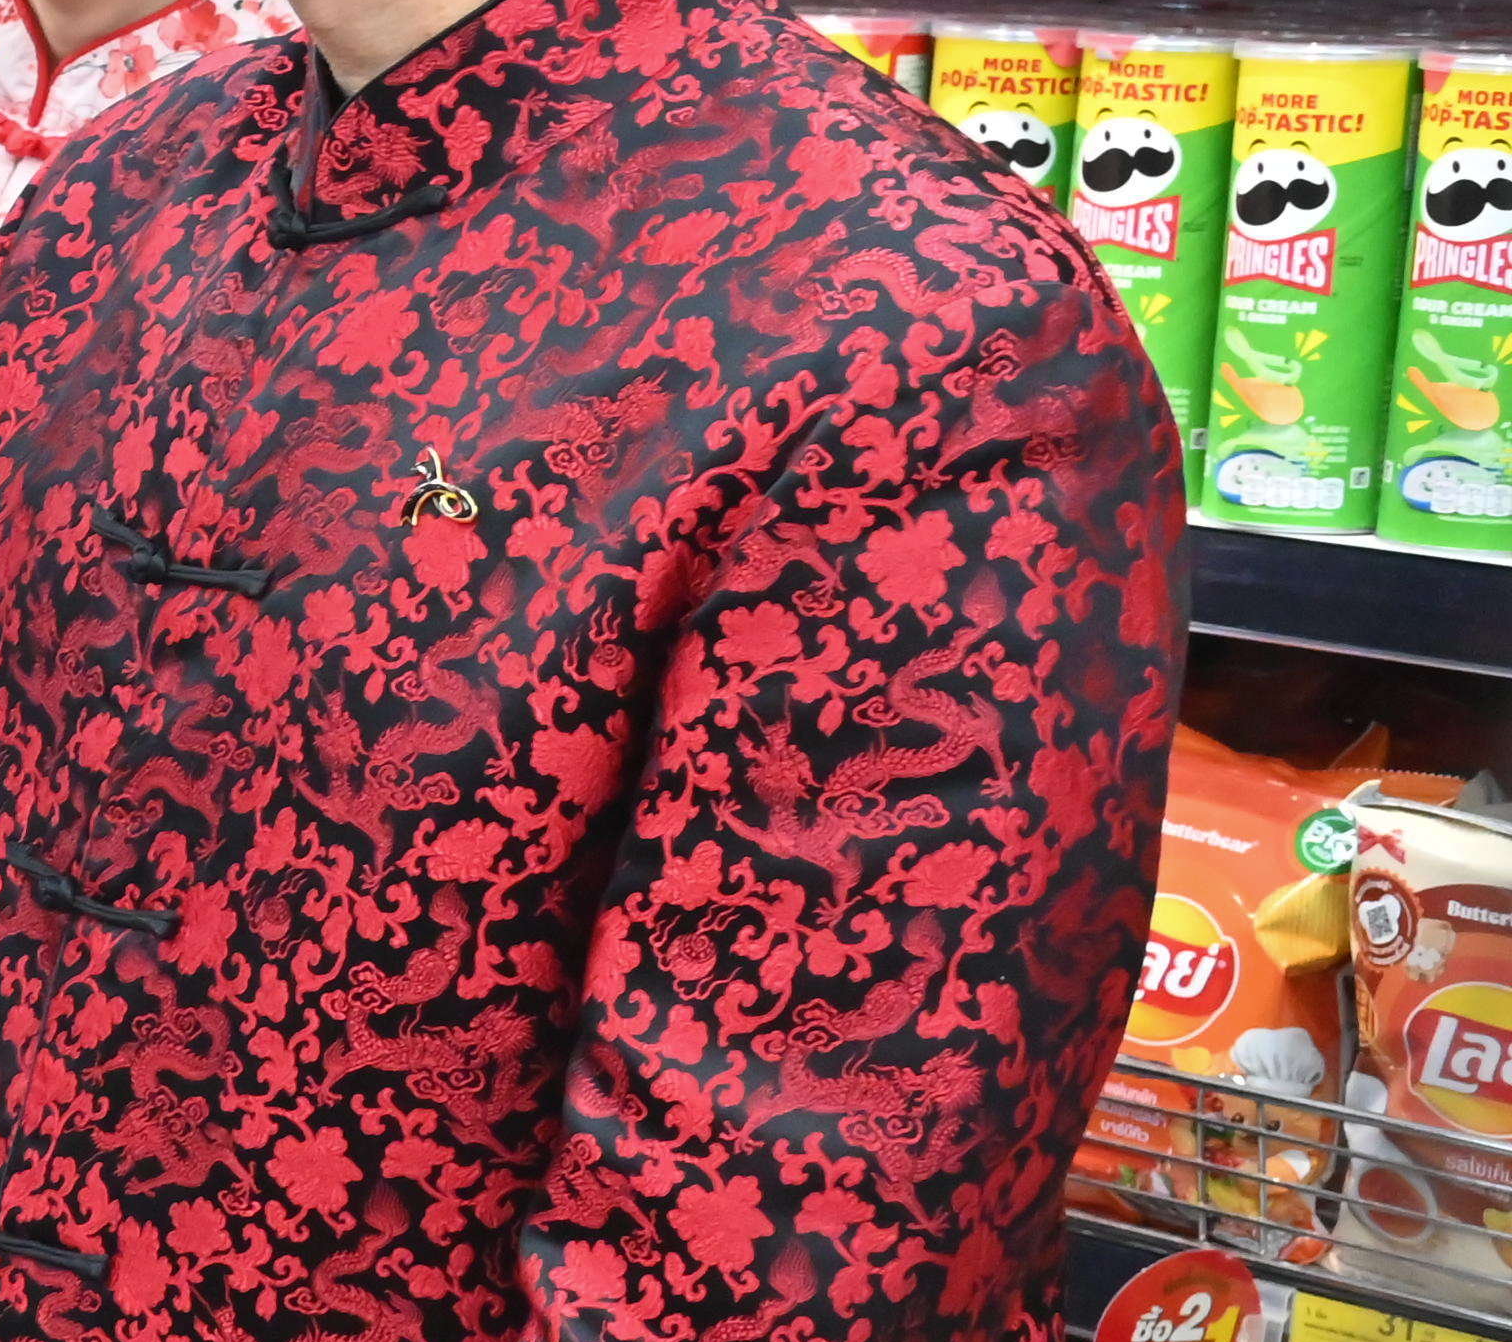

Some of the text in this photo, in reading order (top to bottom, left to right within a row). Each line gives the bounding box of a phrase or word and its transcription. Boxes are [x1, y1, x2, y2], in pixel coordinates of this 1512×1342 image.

[983, 57, 1042, 74] MORE
[1108, 62, 1165, 79] MORE
[1261, 93, 1318, 110] MORE
[1225, 229, 1330, 289] PRINGLES
